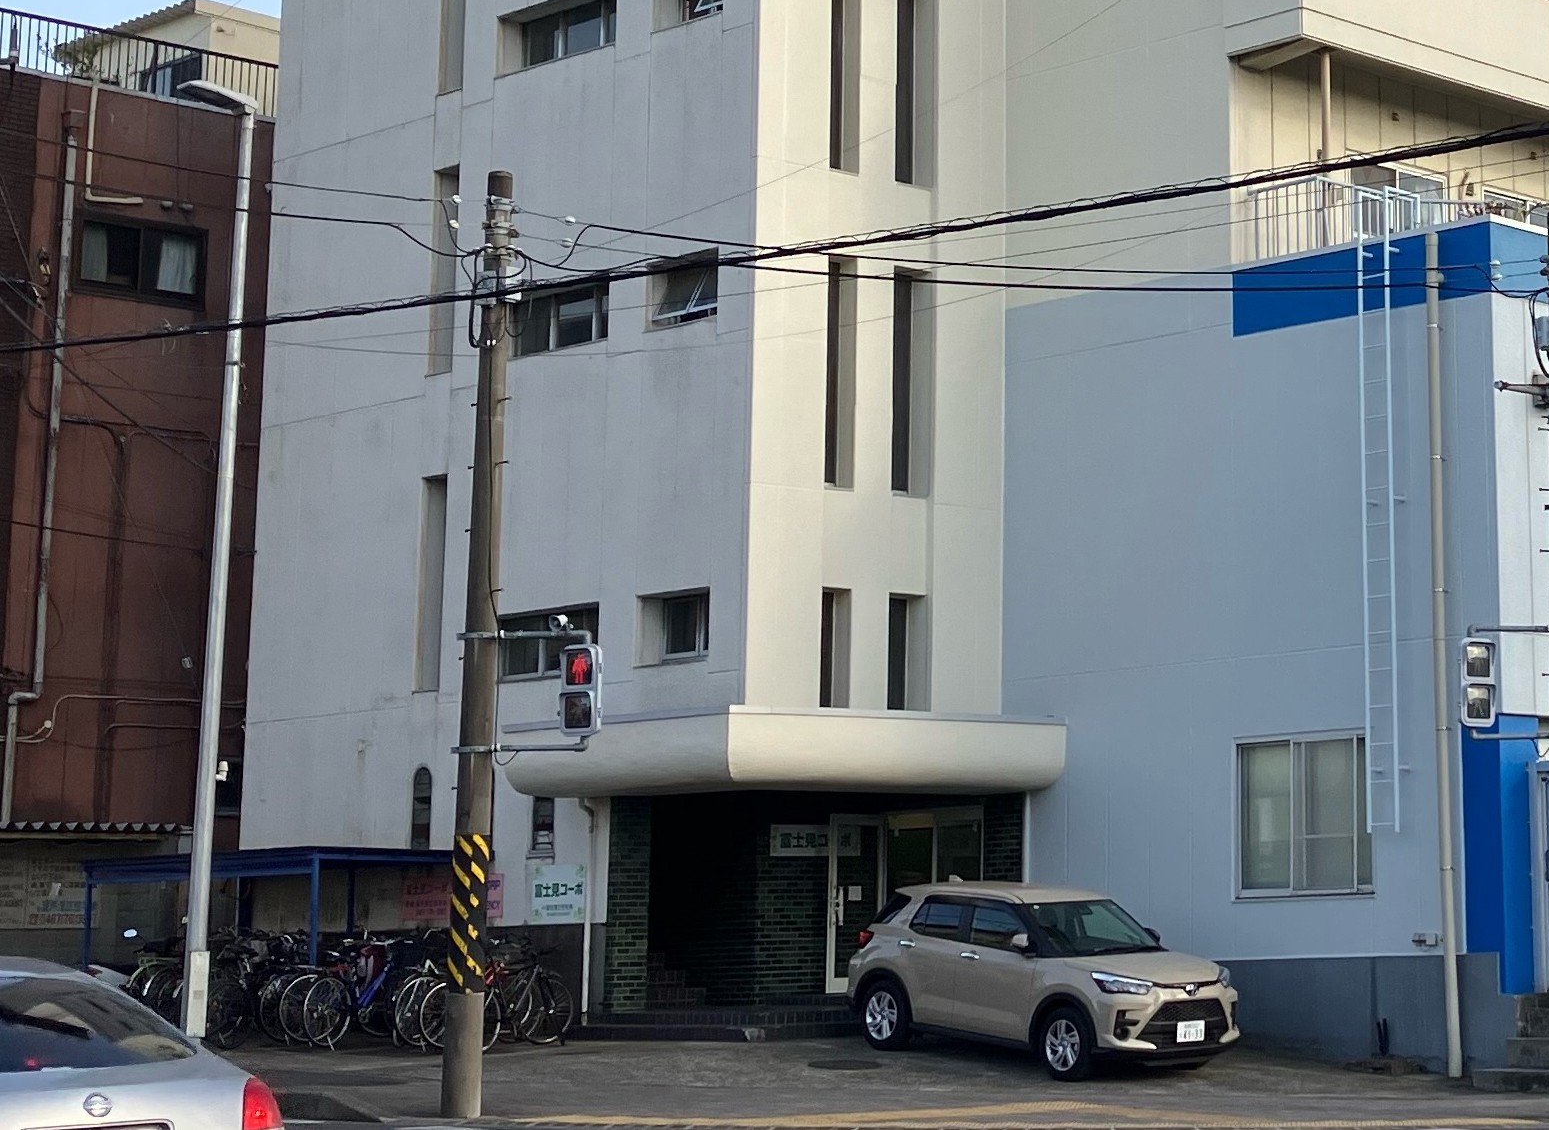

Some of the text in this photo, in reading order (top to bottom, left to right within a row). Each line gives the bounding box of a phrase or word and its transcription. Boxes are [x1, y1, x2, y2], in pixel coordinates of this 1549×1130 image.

[780, 832, 852, 848] 富士見コポ
[534, 881, 583, 898] 富士見コーポ
